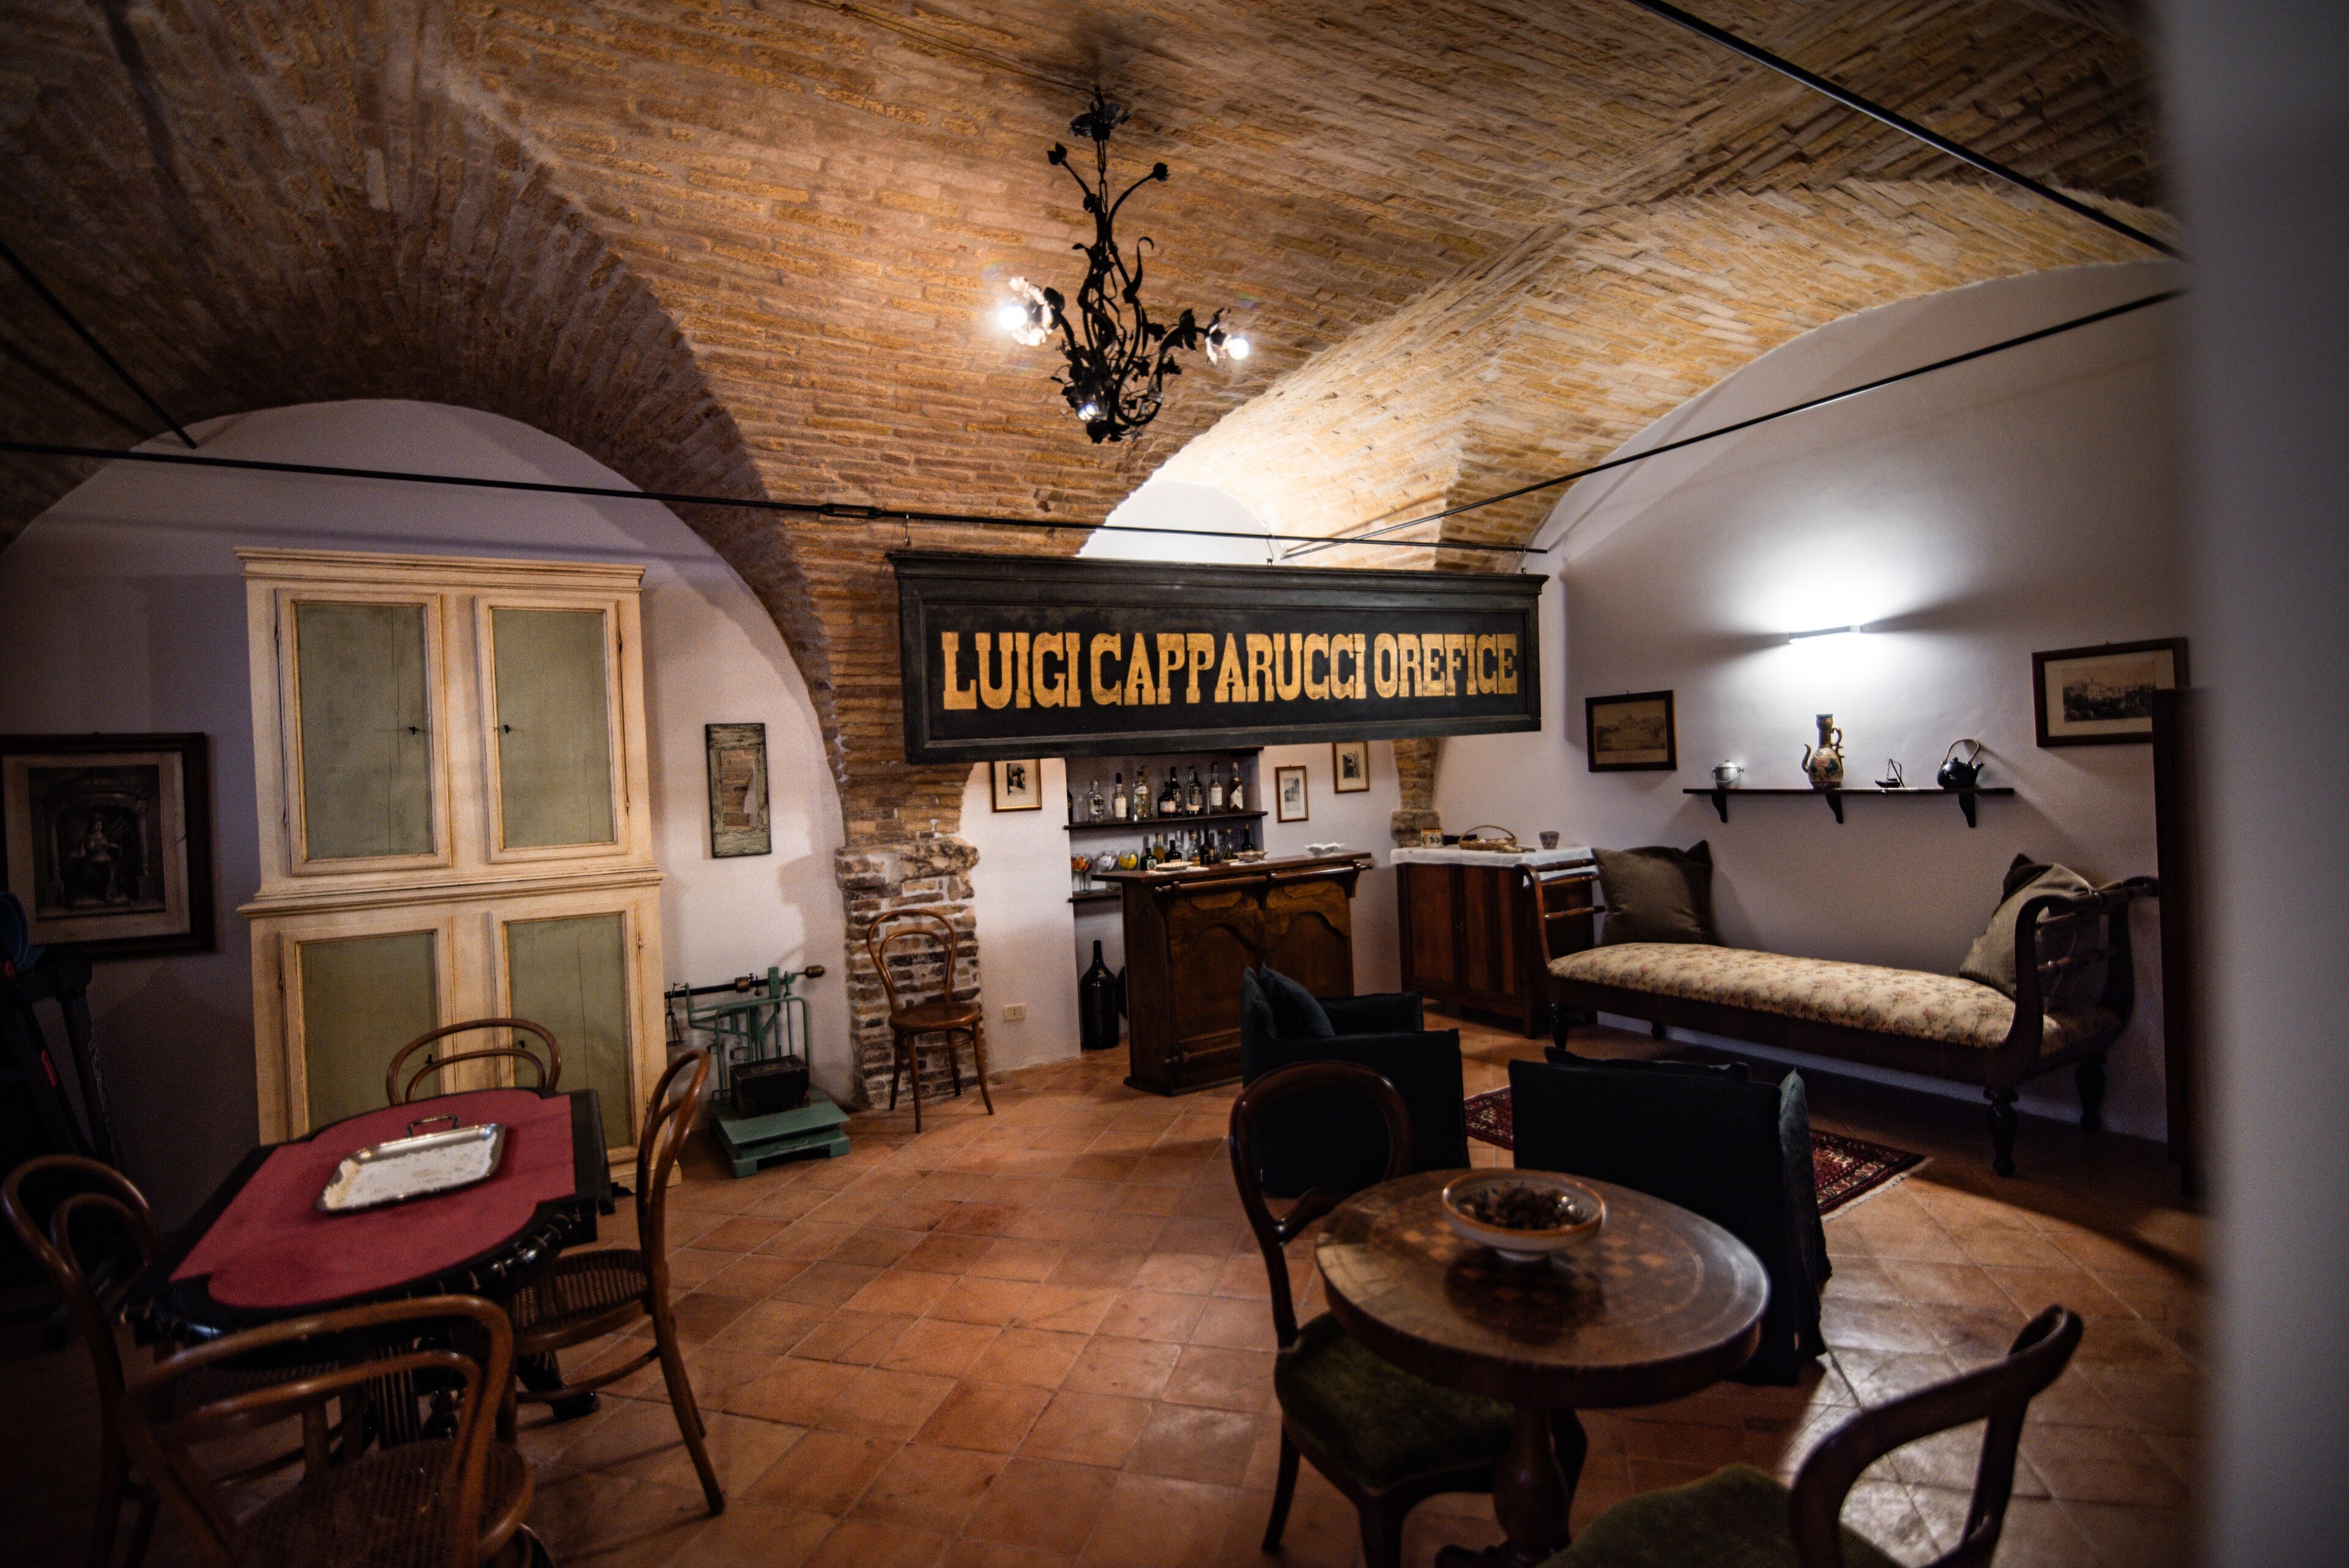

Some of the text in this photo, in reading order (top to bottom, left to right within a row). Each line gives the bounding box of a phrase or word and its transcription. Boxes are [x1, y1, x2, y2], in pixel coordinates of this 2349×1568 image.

[941, 631, 1518, 710] LUIGI CAPPARUCCI OREFICE
